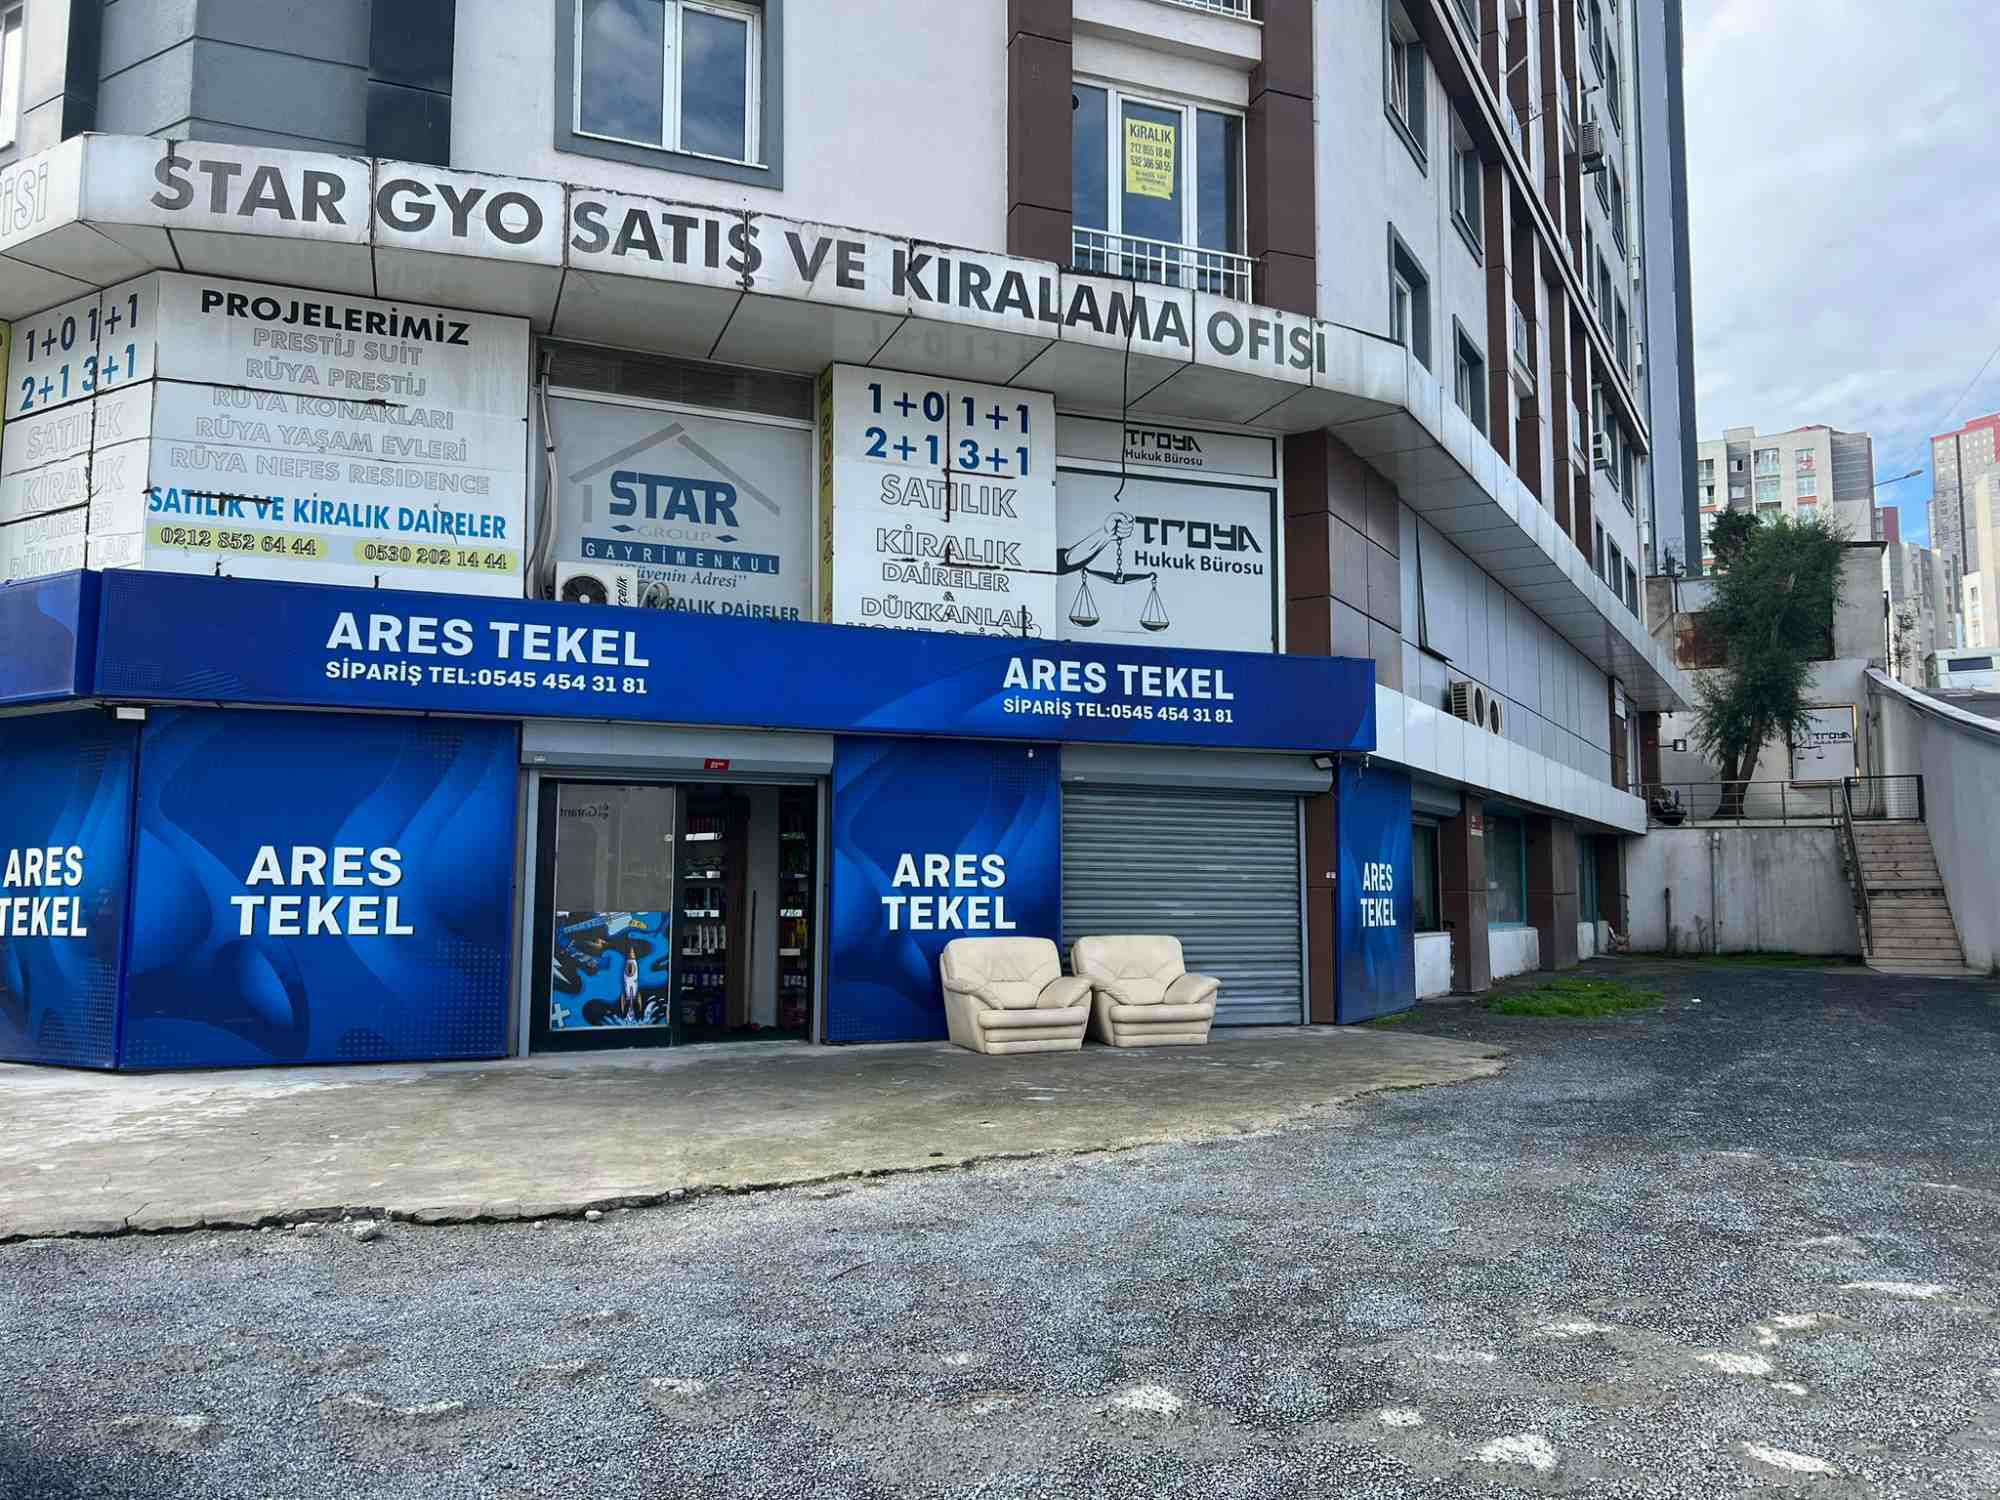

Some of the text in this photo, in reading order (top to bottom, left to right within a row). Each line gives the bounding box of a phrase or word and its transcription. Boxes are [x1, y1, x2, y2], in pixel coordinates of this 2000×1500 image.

[0, 163, 48, 236] İSİ
[150, 156, 347, 224] STAR
[376, 178, 544, 243] GYO
[571, 201, 762, 287] SATIŞ
[785, 231, 866, 290] VE
[892, 249, 1189, 347] KIRALAMA
[1207, 310, 1327, 373] OFİSİ
[26, 293, 138, 362] 1+0 1+1
[201, 289, 472, 346] PROJELERİMİZ
[253, 327, 424, 366] PRESTİJ SUİT
[20, 343, 135, 411] 2+1 3+1
[246, 355, 426, 396] RÜYA PRESTİJ
[296, 397, 454, 431] KONAKLARI
[868, 383, 1028, 433] 1+0 1+1
[195, 414, 467, 462] RÜYA YAŞAM EVLERİ
[865, 427, 1028, 476] 2+1 3+1
[1125, 449, 1203, 466] Hukuk Bürosu
[170, 445, 490, 495] RÜYA NEFES RESIDENCE
[148, 486, 506, 539] SATILIK VE KİRALIK DAİRELER
[609, 470, 739, 528] STAR
[881, 474, 1017, 518] SATILIK
[161, 527, 211, 546] 0212
[261, 535, 286, 552] 64
[291, 538, 316, 555] 44
[636, 527, 712, 542] GROUP
[876, 524, 1021, 566] KİRALIK
[416, 547, 450, 565] 202
[457, 551, 479, 567] 14
[484, 553, 507, 569] 44
[585, 541, 777, 573] GAYRİMENKUL
[882, 562, 1010, 592] DAİRELER
[1135, 550, 1264, 575] Hukuk Bürosu
[943, 591, 955, 601] &
[326, 612, 649, 667] ARES TEKEL
[326, 657, 648, 694] SİPARİŞ TEL:0545 454 31 81
[1003, 657, 1234, 700] ARES TEKEL
[1003, 696, 1234, 723] SİPARİŞ TEL:0545 454 31 81
[3, 845, 84, 888] ARES
[246, 845, 402, 886] ARES
[892, 853, 1006, 888] ARES
[1362, 862, 1393, 892] ARES
[0, 896, 87, 937] TEKEL
[231, 895, 414, 936] TEKEL
[882, 896, 1016, 931] TEKEL
[1360, 898, 1397, 928] TEKEL
